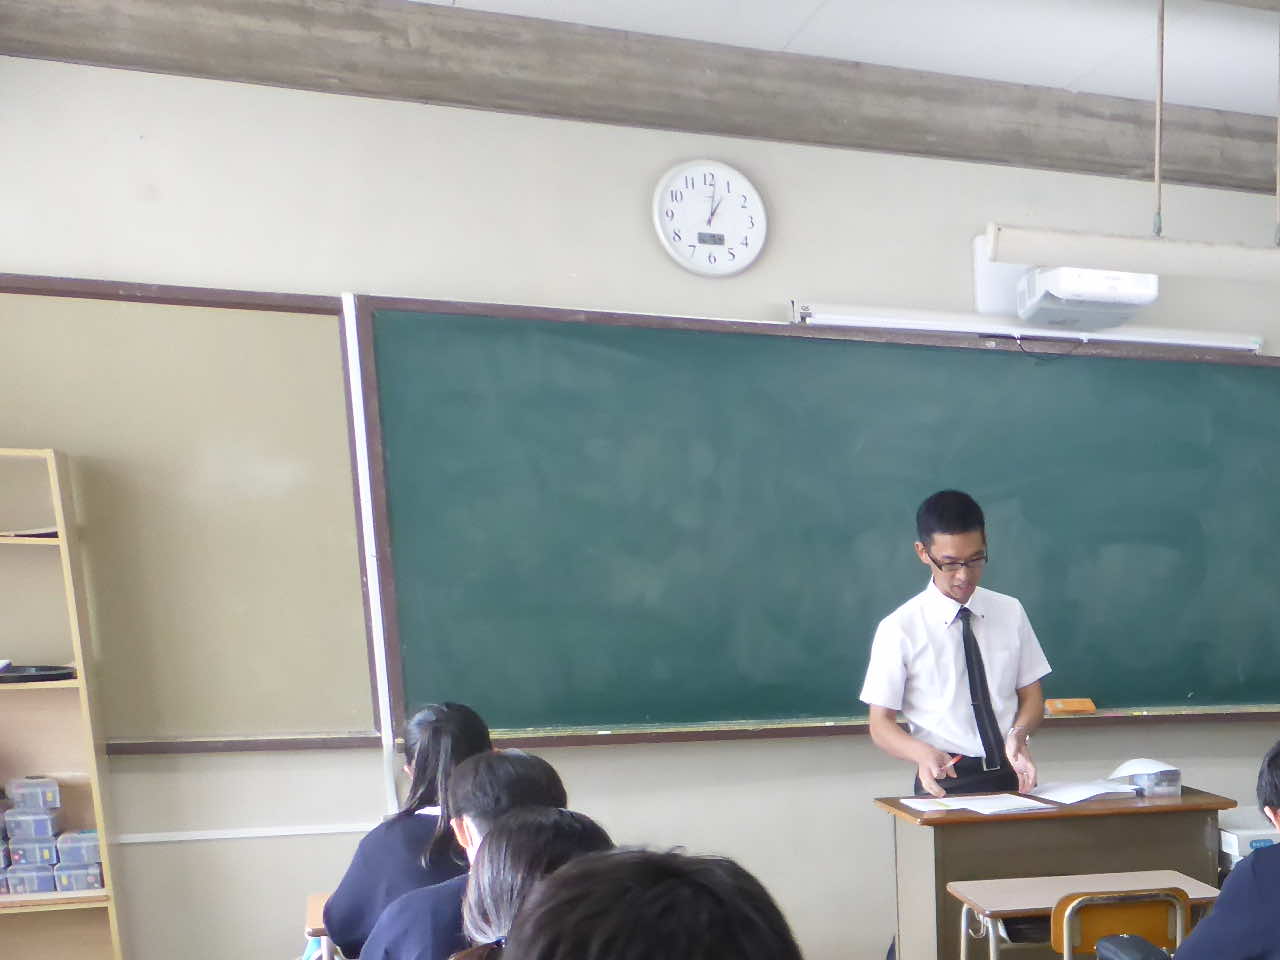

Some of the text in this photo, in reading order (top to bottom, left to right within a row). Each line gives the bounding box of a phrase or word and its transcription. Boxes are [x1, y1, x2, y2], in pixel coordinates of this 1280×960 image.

[685, 175, 694, 190] 11
[704, 172, 715, 187] 12
[727, 181, 731, 193] 1
[671, 190, 683, 203] 10
[741, 194, 748, 208] 2
[666, 208, 674, 221] 9
[747, 216, 754, 229] 3
[672, 229, 682, 242] 8
[740, 235, 749, 248] 4
[688, 244, 697, 257] 7
[727, 247, 736, 261] 5
[707, 252, 716, 264] 6
